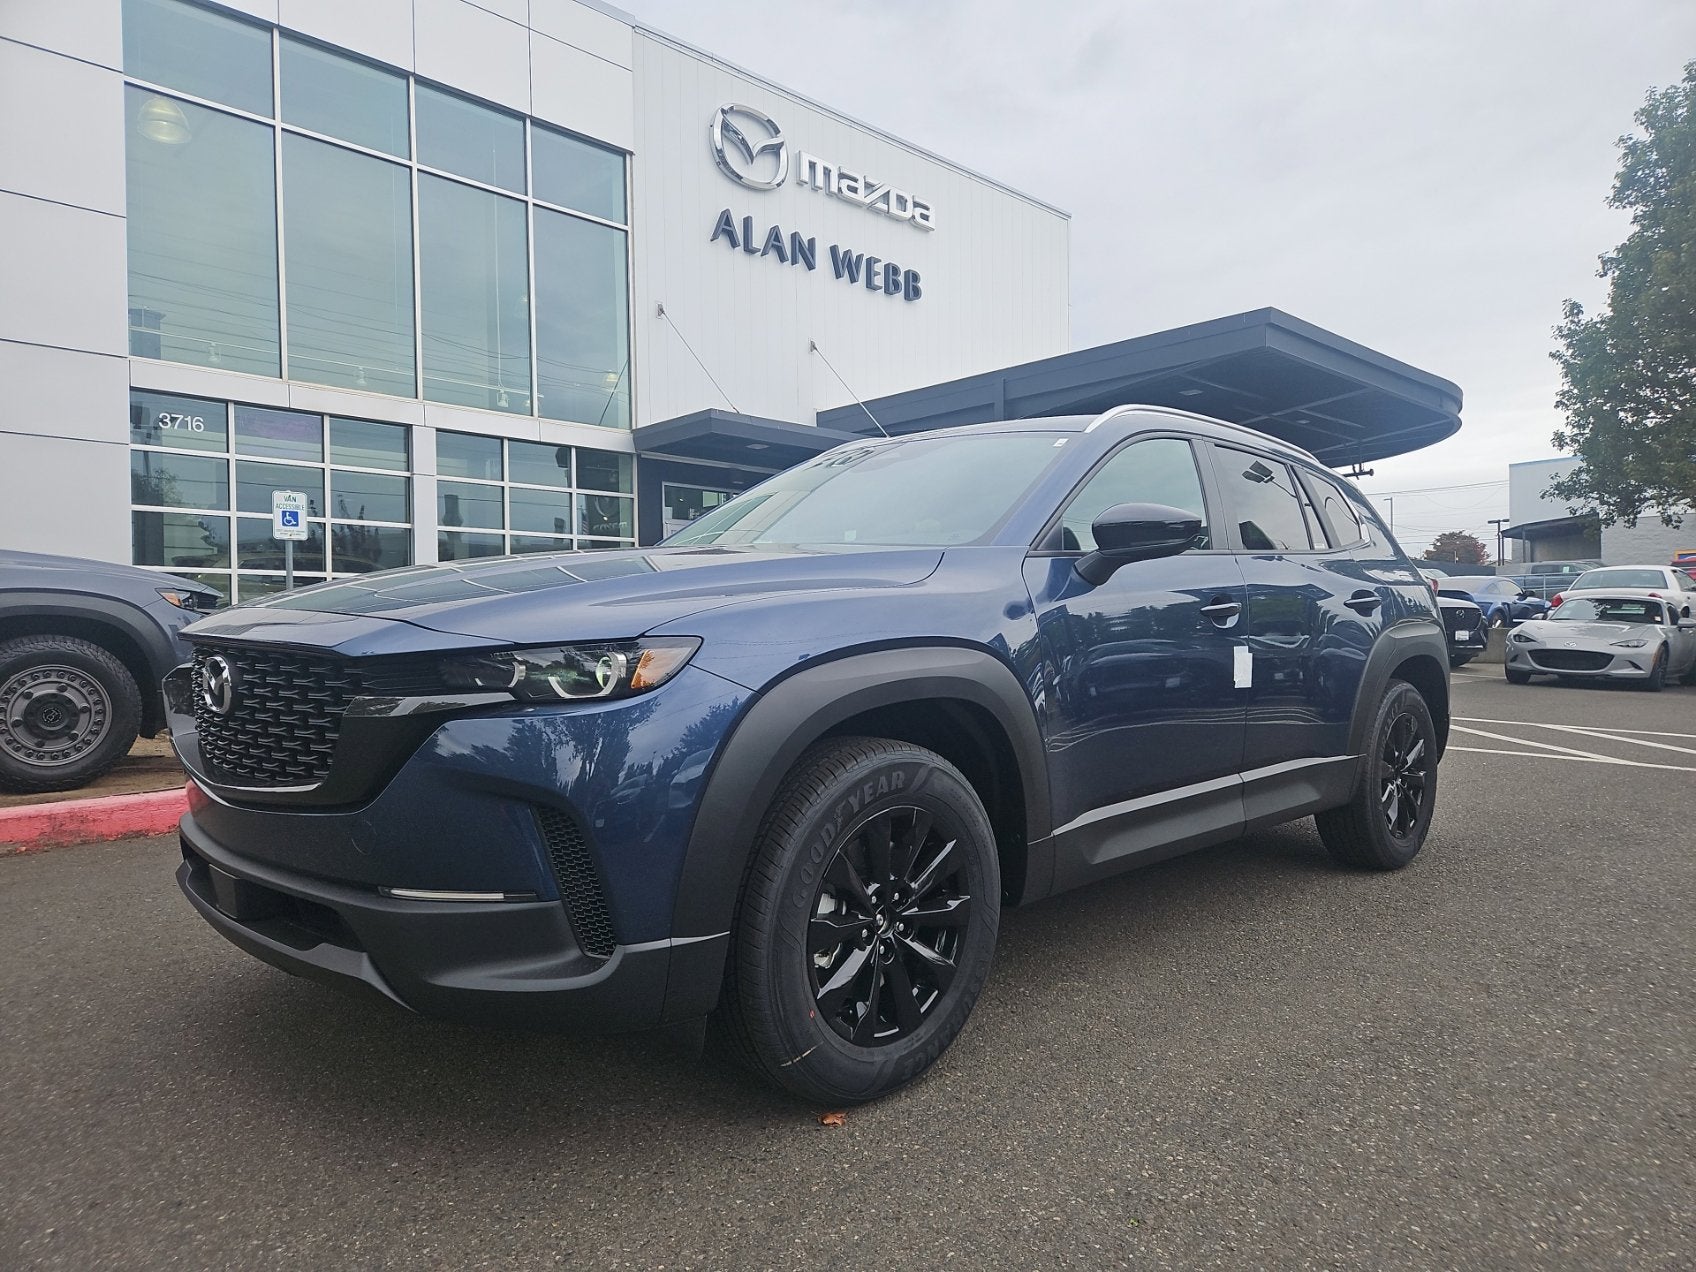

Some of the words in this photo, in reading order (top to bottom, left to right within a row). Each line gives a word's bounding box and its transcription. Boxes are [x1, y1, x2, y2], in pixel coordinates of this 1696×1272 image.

[710, 208, 816, 271] ALAN
[829, 244, 922, 301] WEBB
[158, 412, 205, 433] 3716
[283, 495, 297, 503] VAN
[792, 770, 905, 908] GOODYEAR
